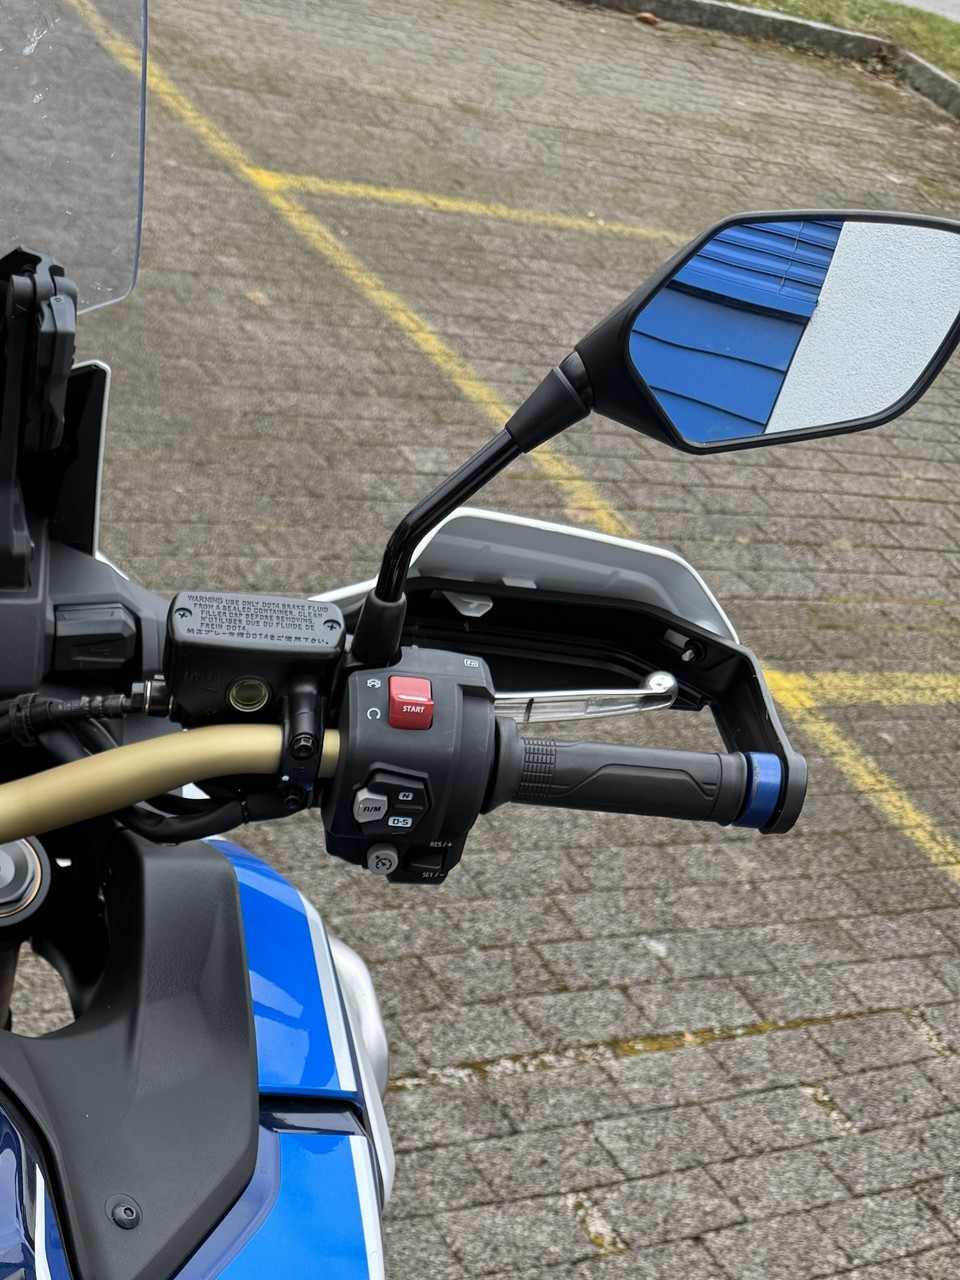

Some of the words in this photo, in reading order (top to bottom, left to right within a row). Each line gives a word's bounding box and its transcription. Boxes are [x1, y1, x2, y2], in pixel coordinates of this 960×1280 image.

[187, 595, 223, 605] WARNING
[242, 600, 260, 608] ONLY
[308, 605, 329, 613] FLUID
[193, 602, 214, 610] FROM
[222, 605, 252, 613] SEALED
[298, 611, 323, 619] CLEAN
[200, 609, 227, 618] FILLER
[402, 705, 425, 713] START
[363, 805, 381, 813] A/M
[392, 818, 409, 826] D-S
